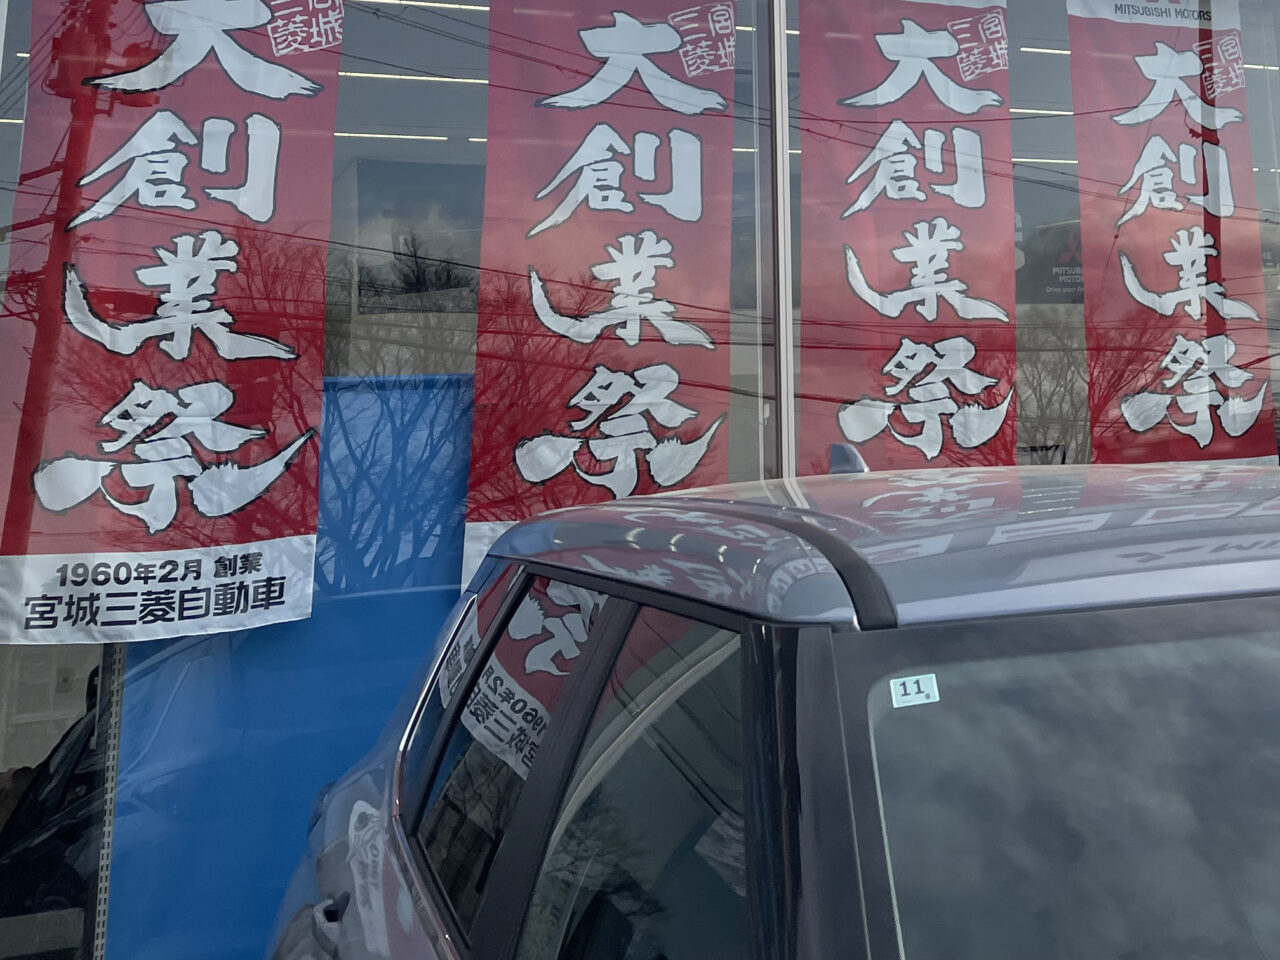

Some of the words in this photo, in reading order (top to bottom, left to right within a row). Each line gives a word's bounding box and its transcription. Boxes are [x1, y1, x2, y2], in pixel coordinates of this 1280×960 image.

[1115, 3, 1171, 18] MITSUBISHI
[1175, 8, 1212, 21] MOTORS
[512, 10, 729, 499] 大創業祭
[837, 17, 1015, 461] 大創業祭
[1111, 41, 1270, 449] 大創業祭
[56, 557, 203, 587] 1960年2月
[213, 552, 263, 578] 創業
[23, 576, 287, 630] 宮城三菱自動車
[899, 679, 925, 697] 11
